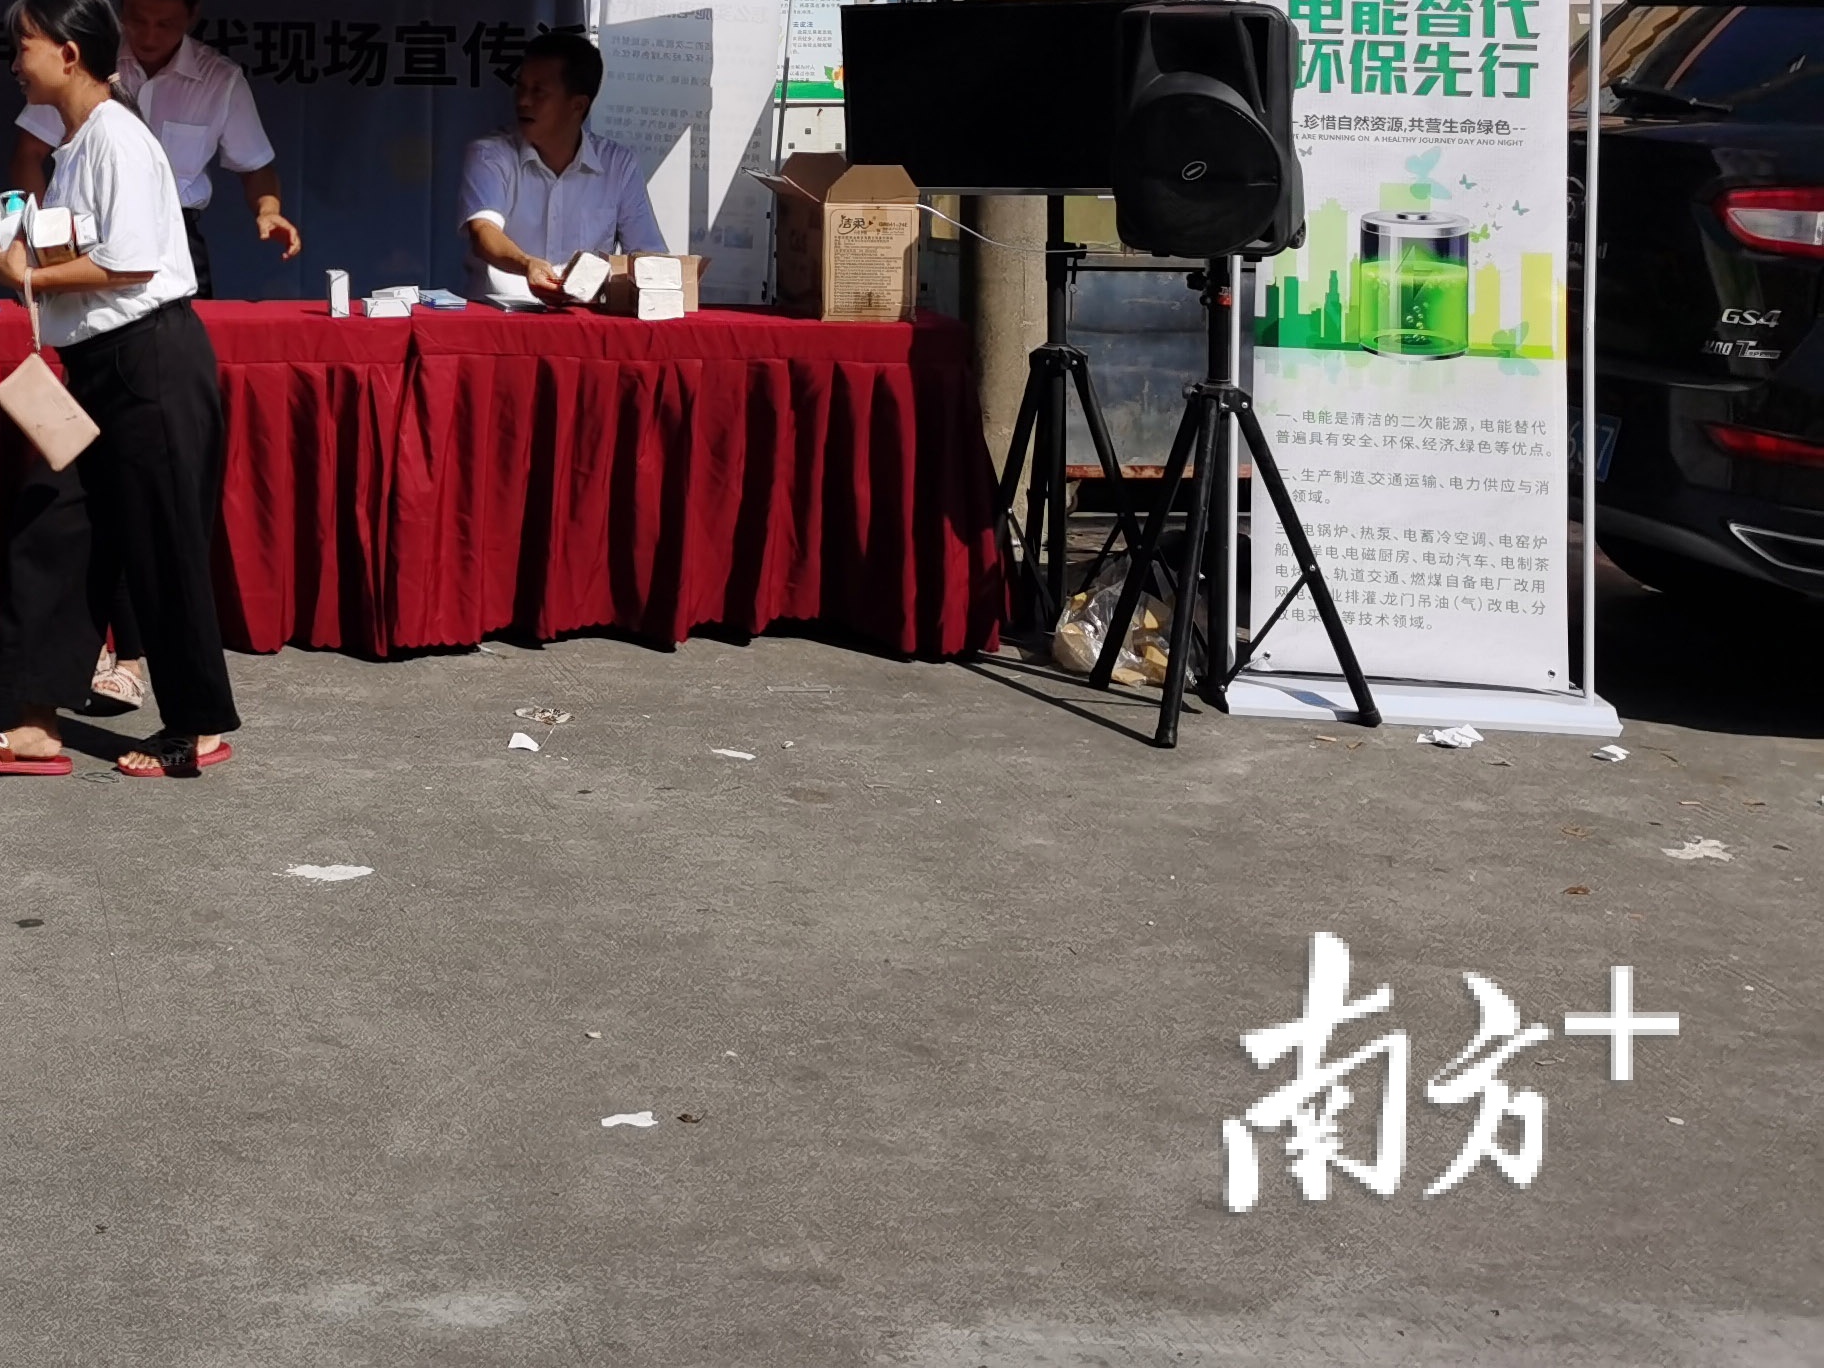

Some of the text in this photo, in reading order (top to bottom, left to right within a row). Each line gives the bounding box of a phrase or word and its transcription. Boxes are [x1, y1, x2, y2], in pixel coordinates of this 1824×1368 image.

[1294, 38, 1540, 99] 环保先行
[1318, 134, 1356, 142] RUNNING
[1382, 136, 1416, 144] HEALTHY
[1418, 136, 1456, 145] JOURNEY
[1457, 137, 1475, 145] DAY
[1476, 138, 1496, 146] AND
[1497, 139, 1524, 147] NIGHT
[1720, 308, 1783, 328] GS4
[1275, 429, 1552, 458] 普遍具有安全、环保、经济、绿色等优点。
[1277, 468, 1550, 496] 二、生产制造、交通运输、电力供应与消
